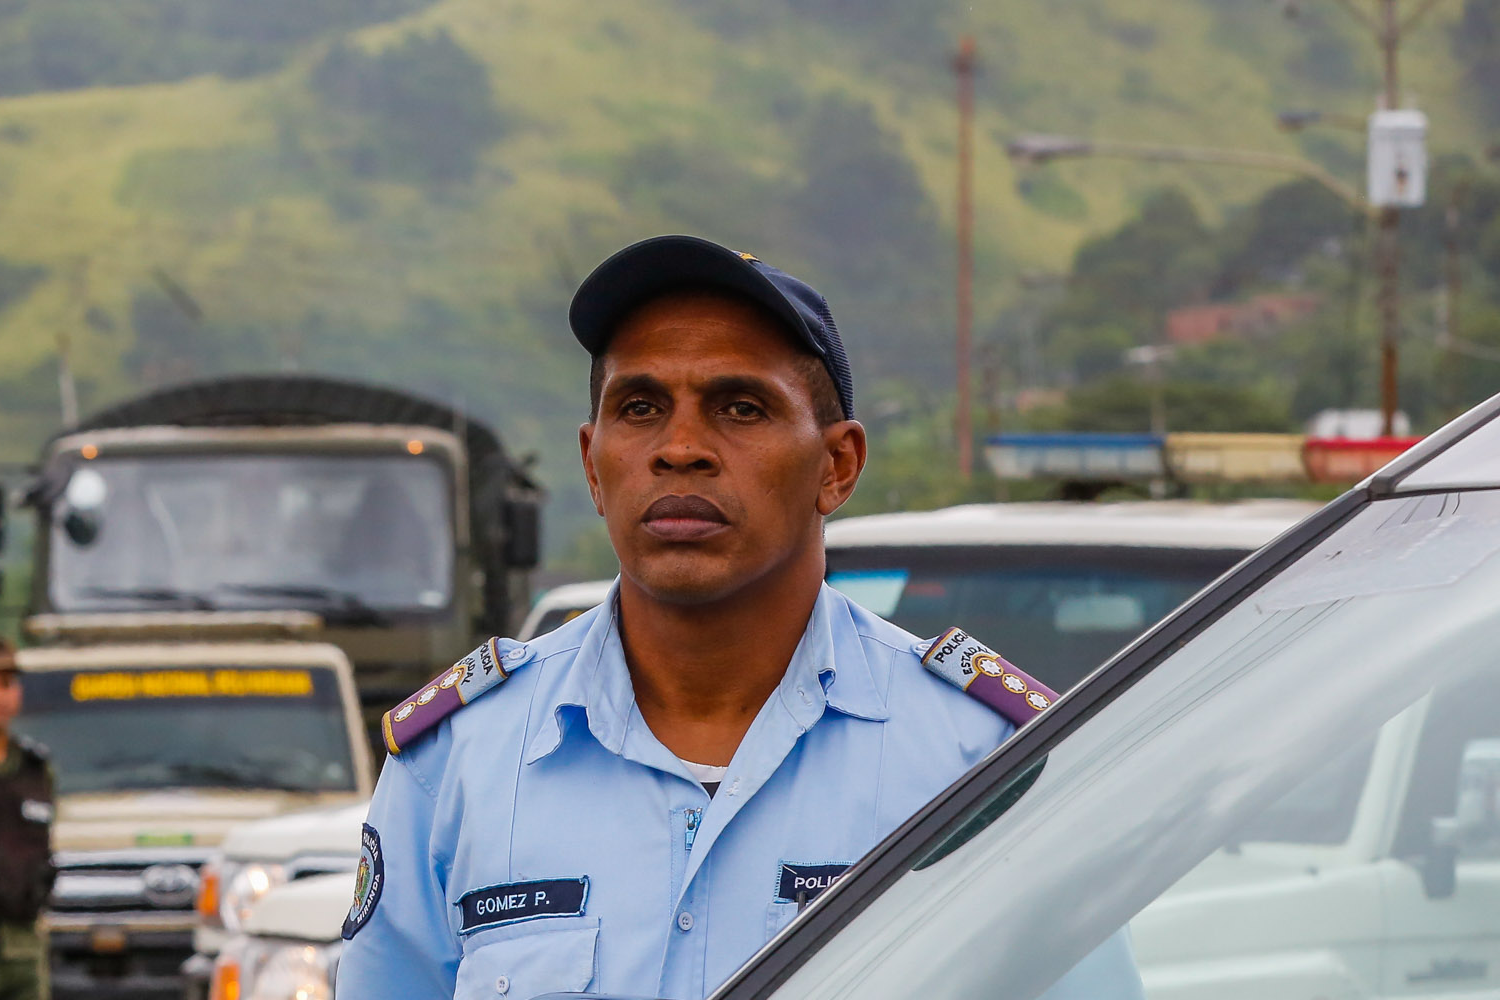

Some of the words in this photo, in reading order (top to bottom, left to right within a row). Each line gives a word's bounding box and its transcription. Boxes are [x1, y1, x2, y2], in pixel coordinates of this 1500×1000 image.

[357, 874, 381, 924] MIRANDA
[476, 893, 527, 916] GOMEZ
[534, 890, 550, 906] P.
